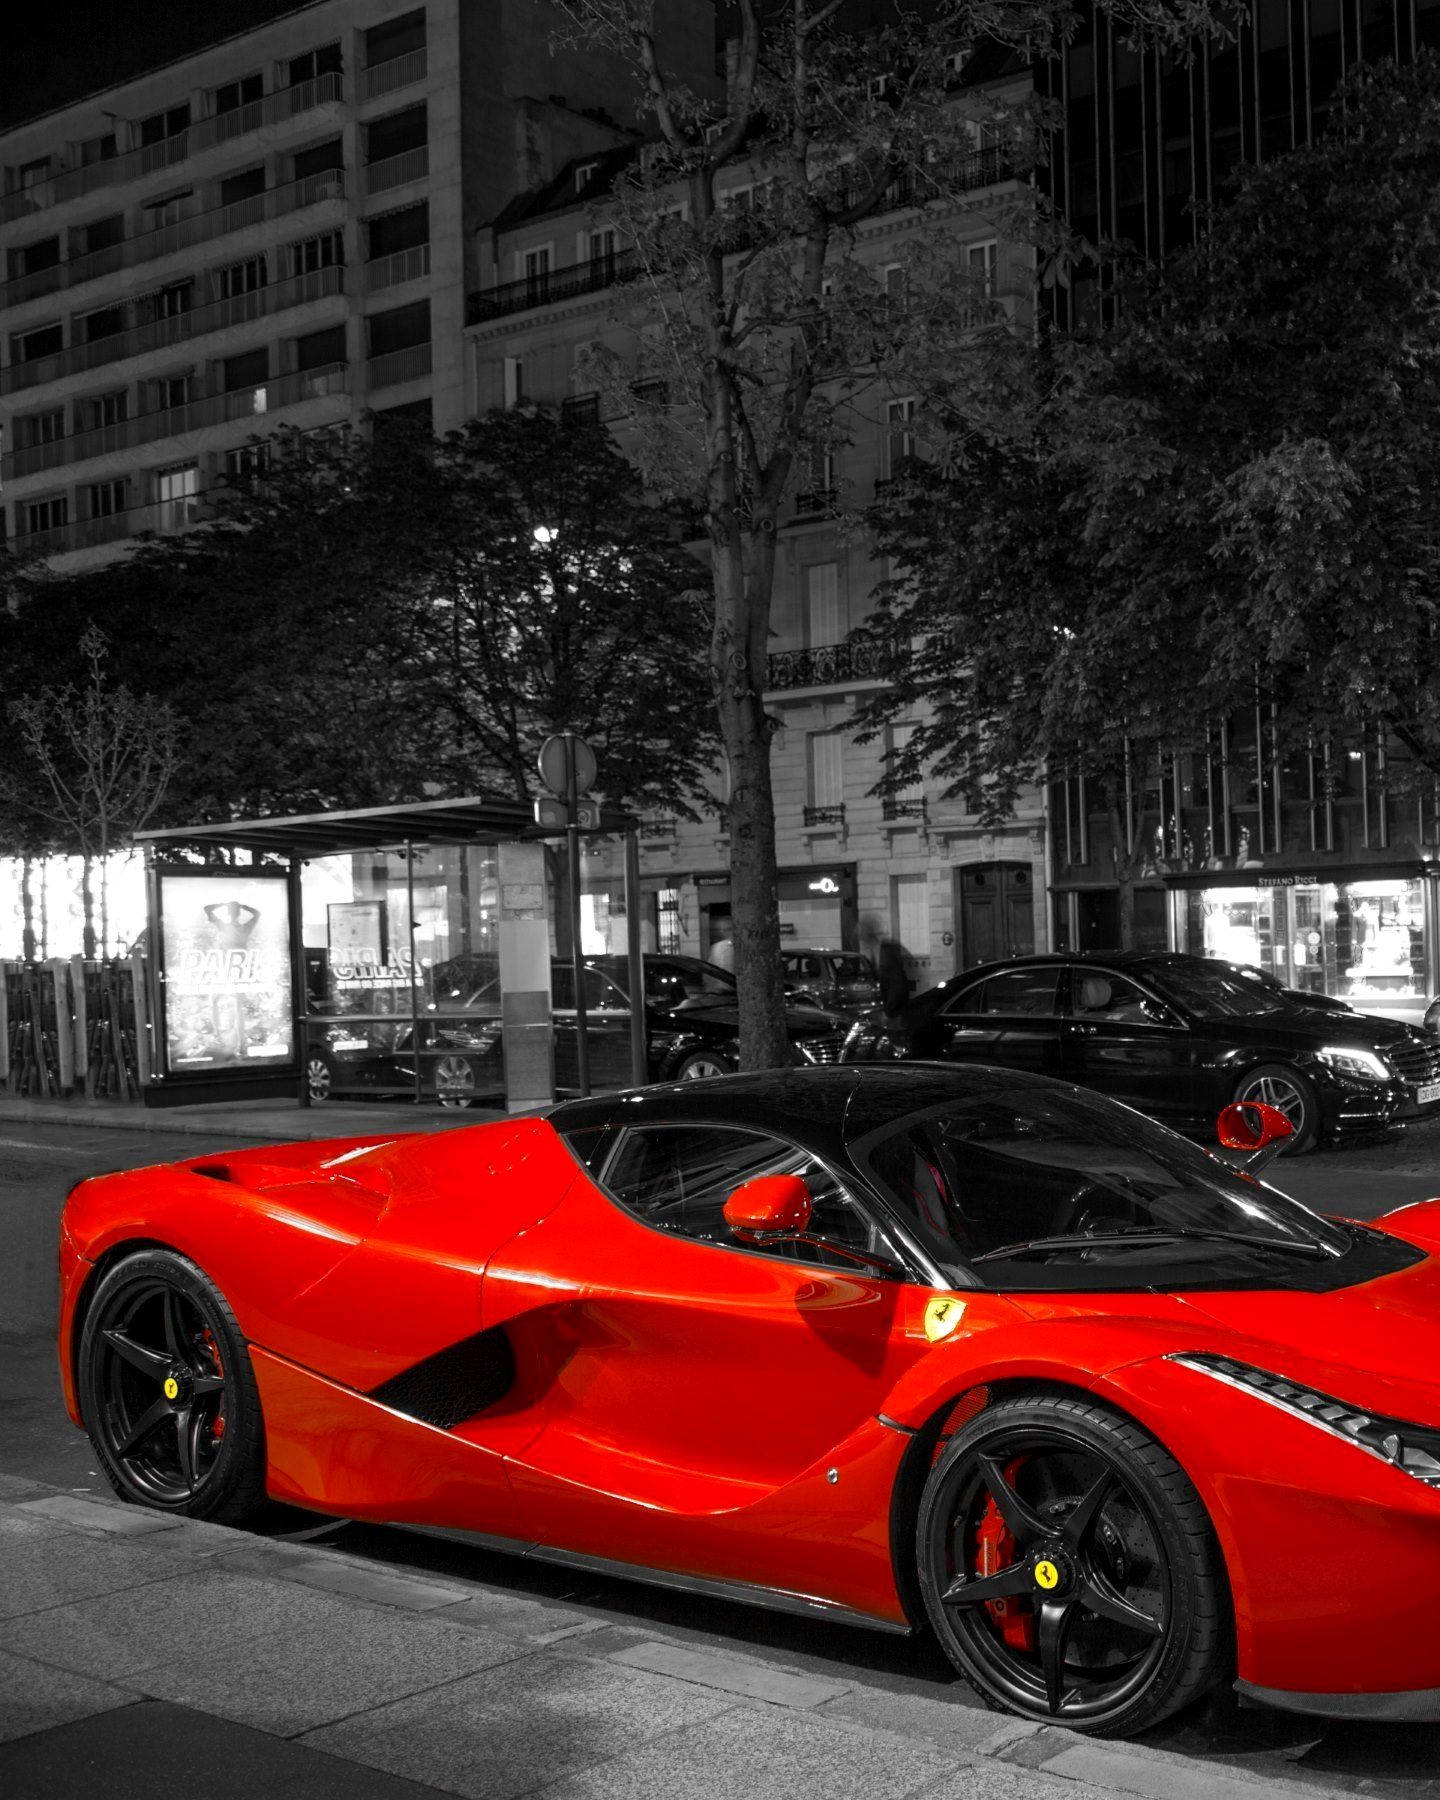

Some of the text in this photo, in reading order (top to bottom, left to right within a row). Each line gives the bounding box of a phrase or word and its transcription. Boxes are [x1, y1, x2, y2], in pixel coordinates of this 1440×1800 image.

[1258, 875, 1317, 886] STEFANO RICCI
[179, 949, 280, 984] PARIS
